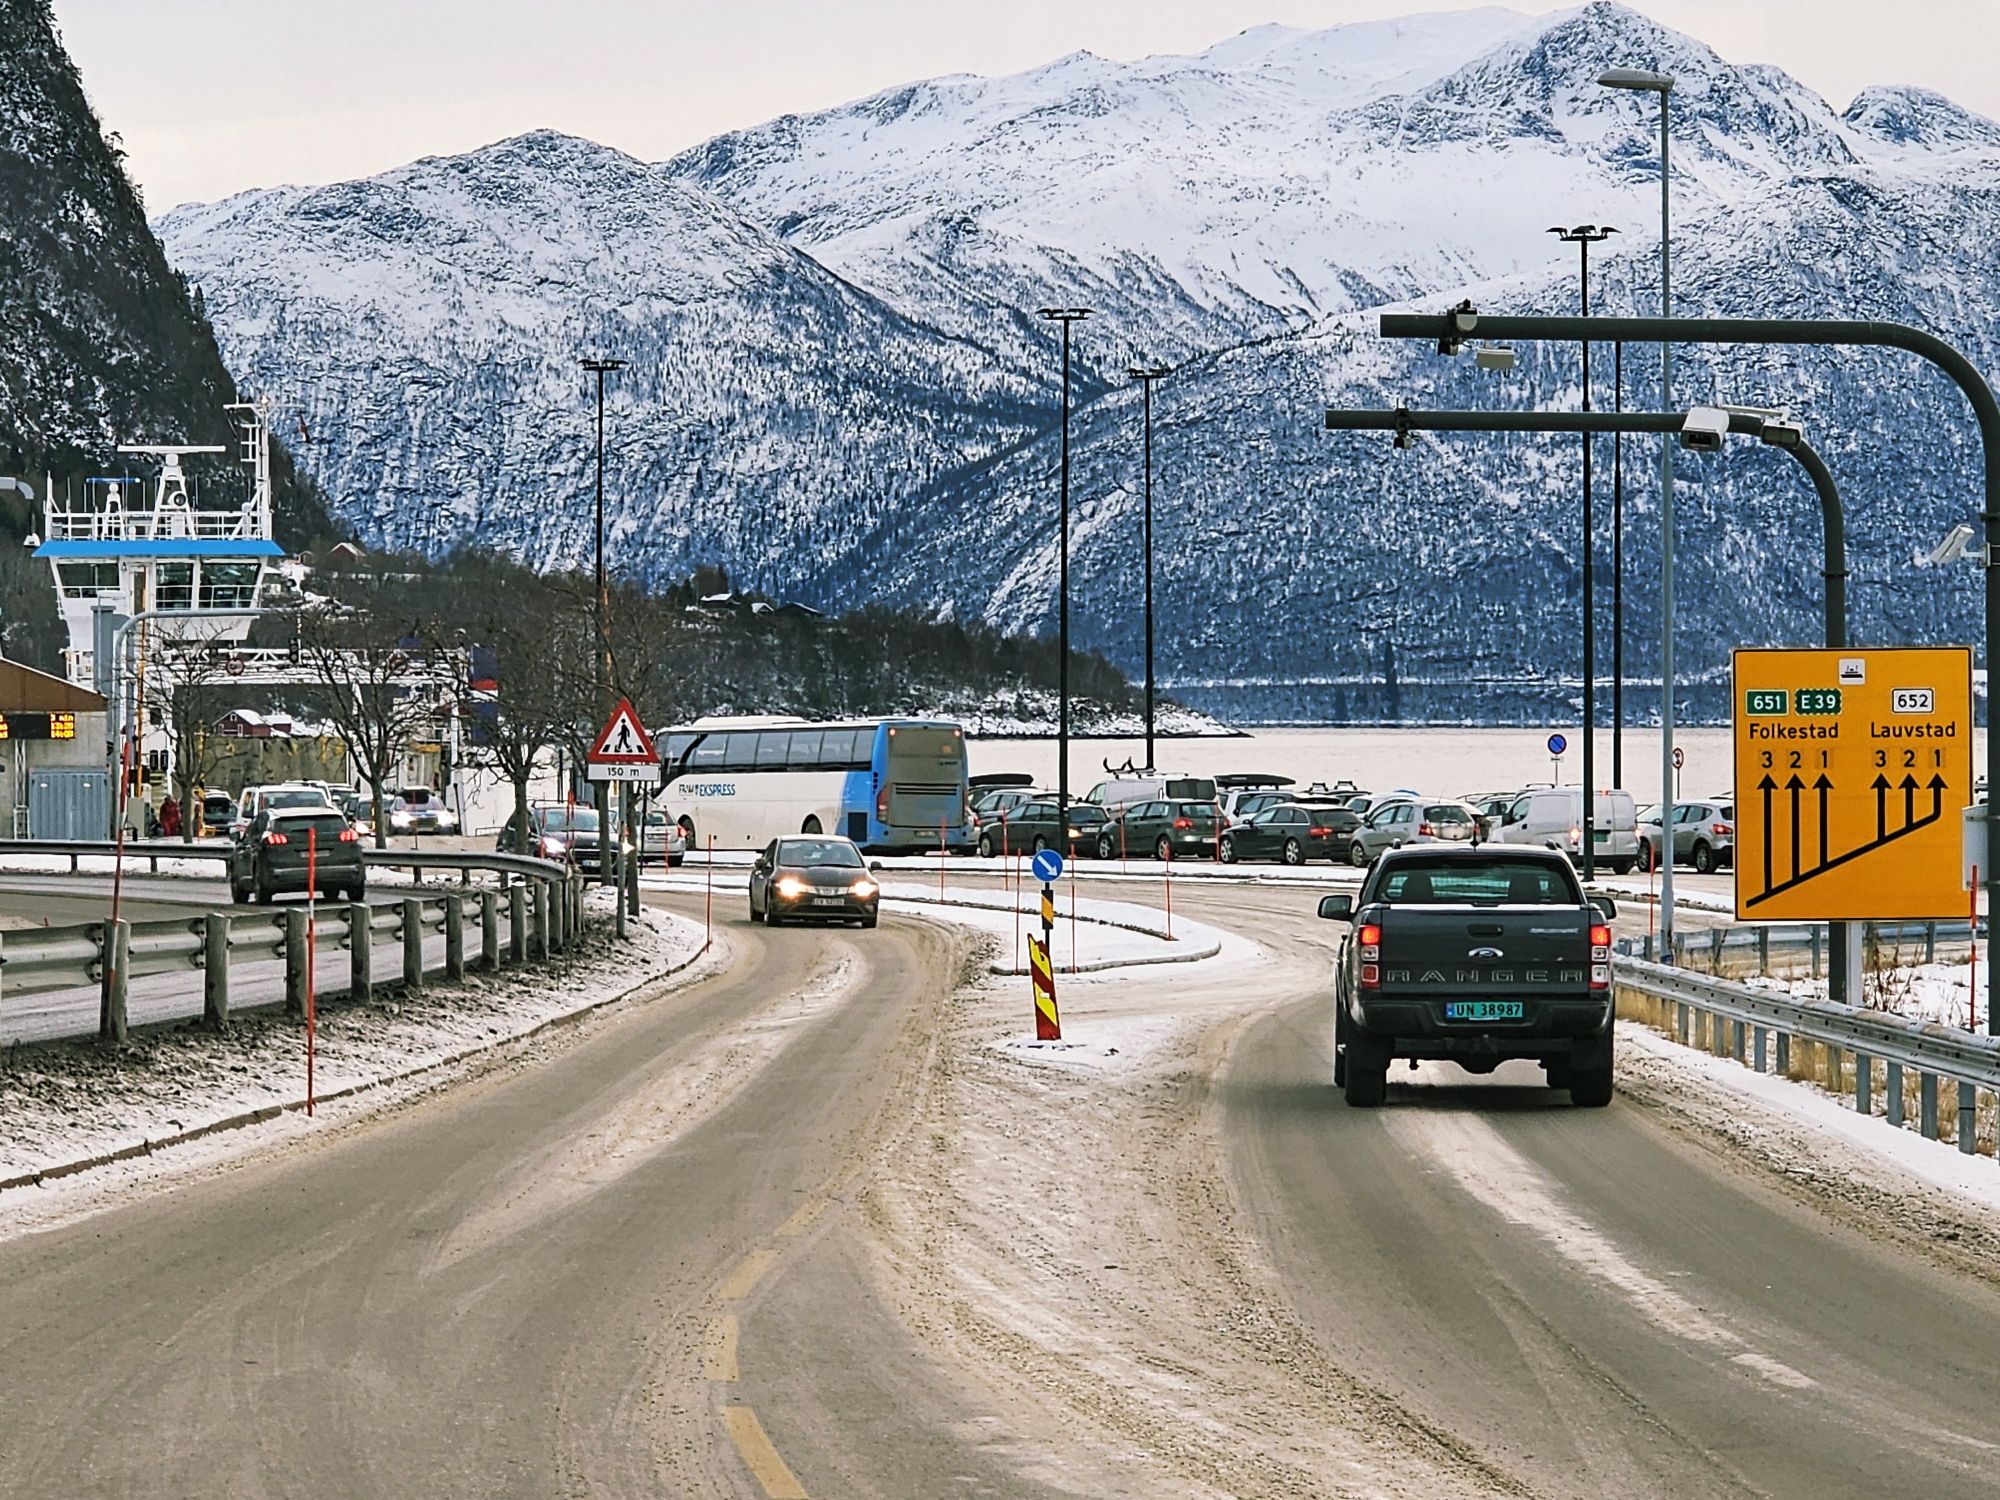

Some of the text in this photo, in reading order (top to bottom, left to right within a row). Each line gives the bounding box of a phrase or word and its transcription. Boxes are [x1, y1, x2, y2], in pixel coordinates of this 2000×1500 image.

[1753, 695, 1781, 710] 651
[1897, 693, 1929, 708] 652
[1749, 722, 1839, 739] Folkestad
[1871, 721, 1956, 738] Lauvstad
[1761, 750, 1828, 769] 3 2 1
[1874, 749, 1941, 768] 3 2 1
[607, 767, 639, 777] 150 m
[699, 784, 736, 797] EKSPRESS
[1387, 970, 1583, 983] RANGER
[1456, 1003, 1521, 1017] UN 38987
